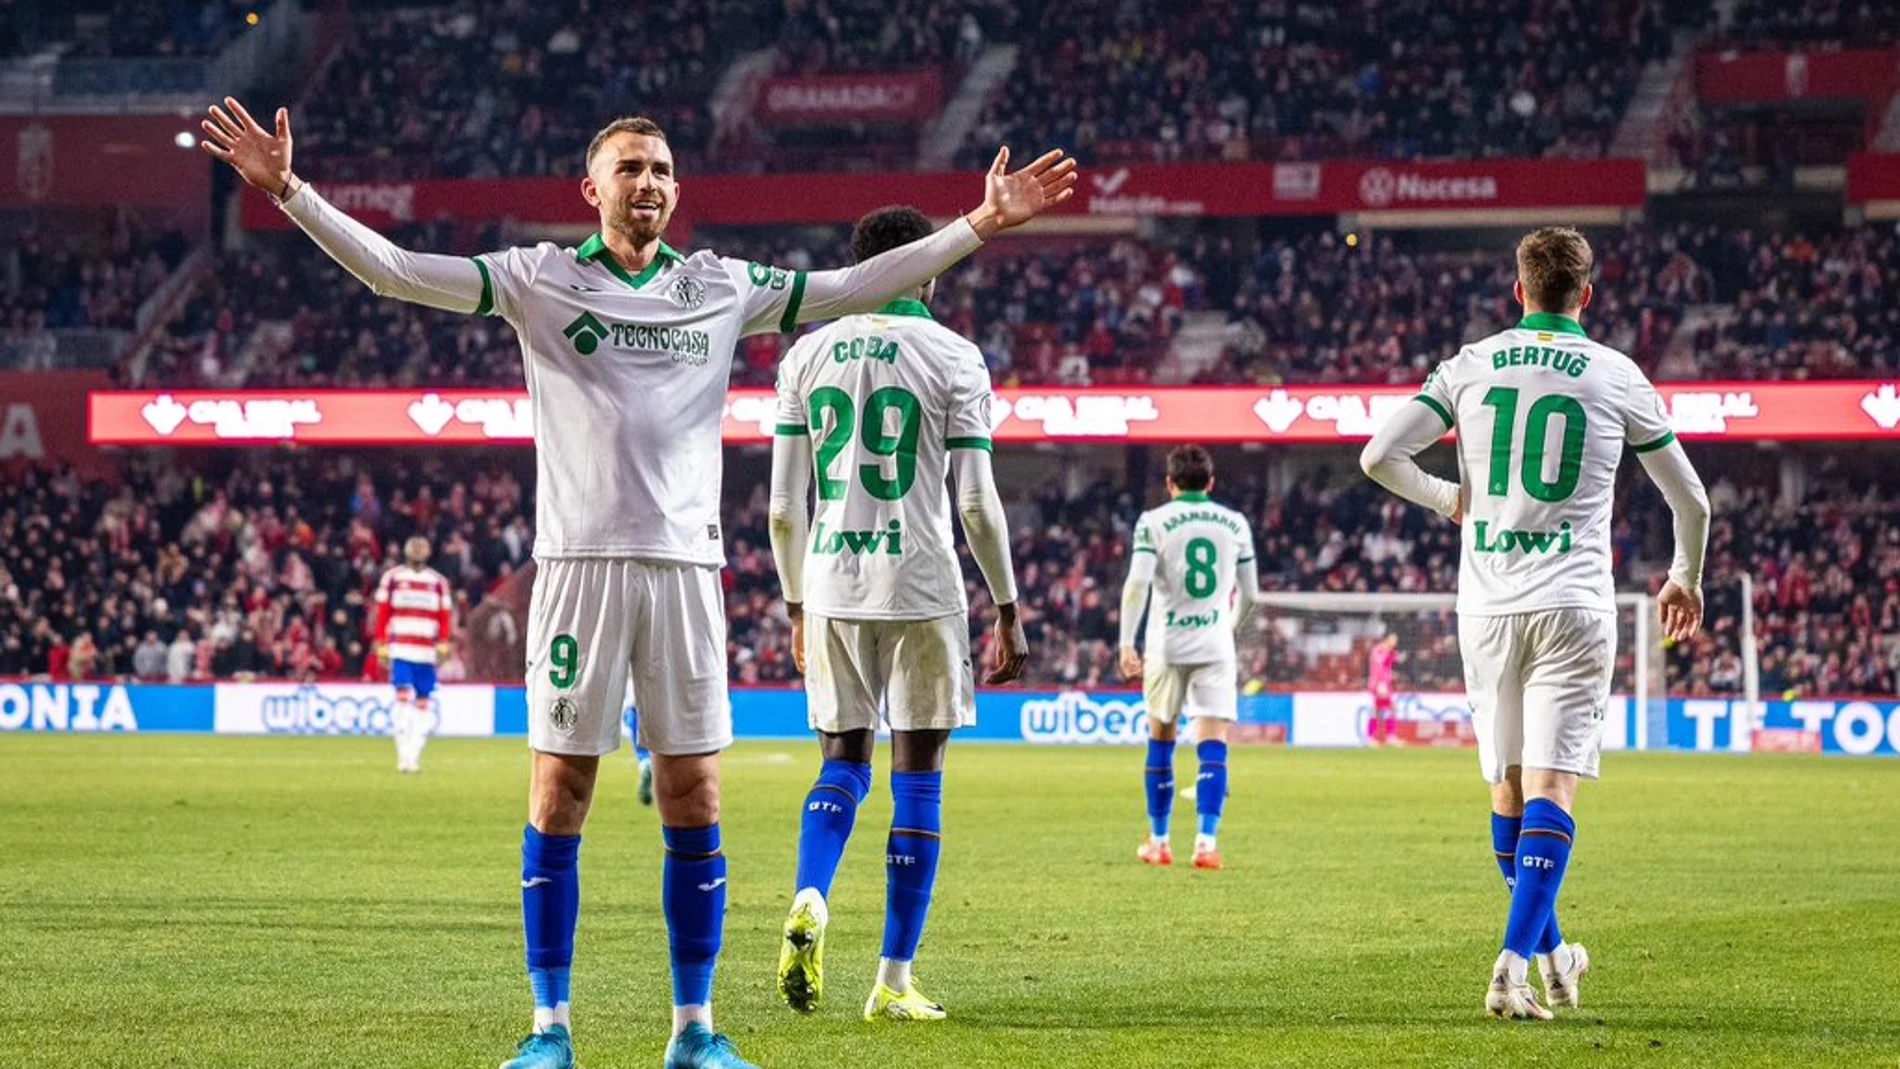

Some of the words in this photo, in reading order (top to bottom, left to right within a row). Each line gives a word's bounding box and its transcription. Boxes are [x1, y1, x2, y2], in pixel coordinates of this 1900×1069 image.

[1397, 172, 1497, 198] Nucesa
[610, 322, 710, 356] TECNOCASA
[833, 335, 899, 364] COBA
[671, 352, 708, 366] GROUP
[1492, 346, 1590, 378] BERTUĞ
[807, 386, 920, 500] 29
[1480, 387, 1587, 502] 10
[812, 519, 902, 554] Lowi
[1473, 521, 1571, 553] Lowi
[1185, 537, 1217, 599] 8
[1166, 608, 1218, 627] Lowi
[549, 634, 578, 689] 9
[809, 801, 842, 813] GTF
[1523, 855, 1555, 870] GTF
